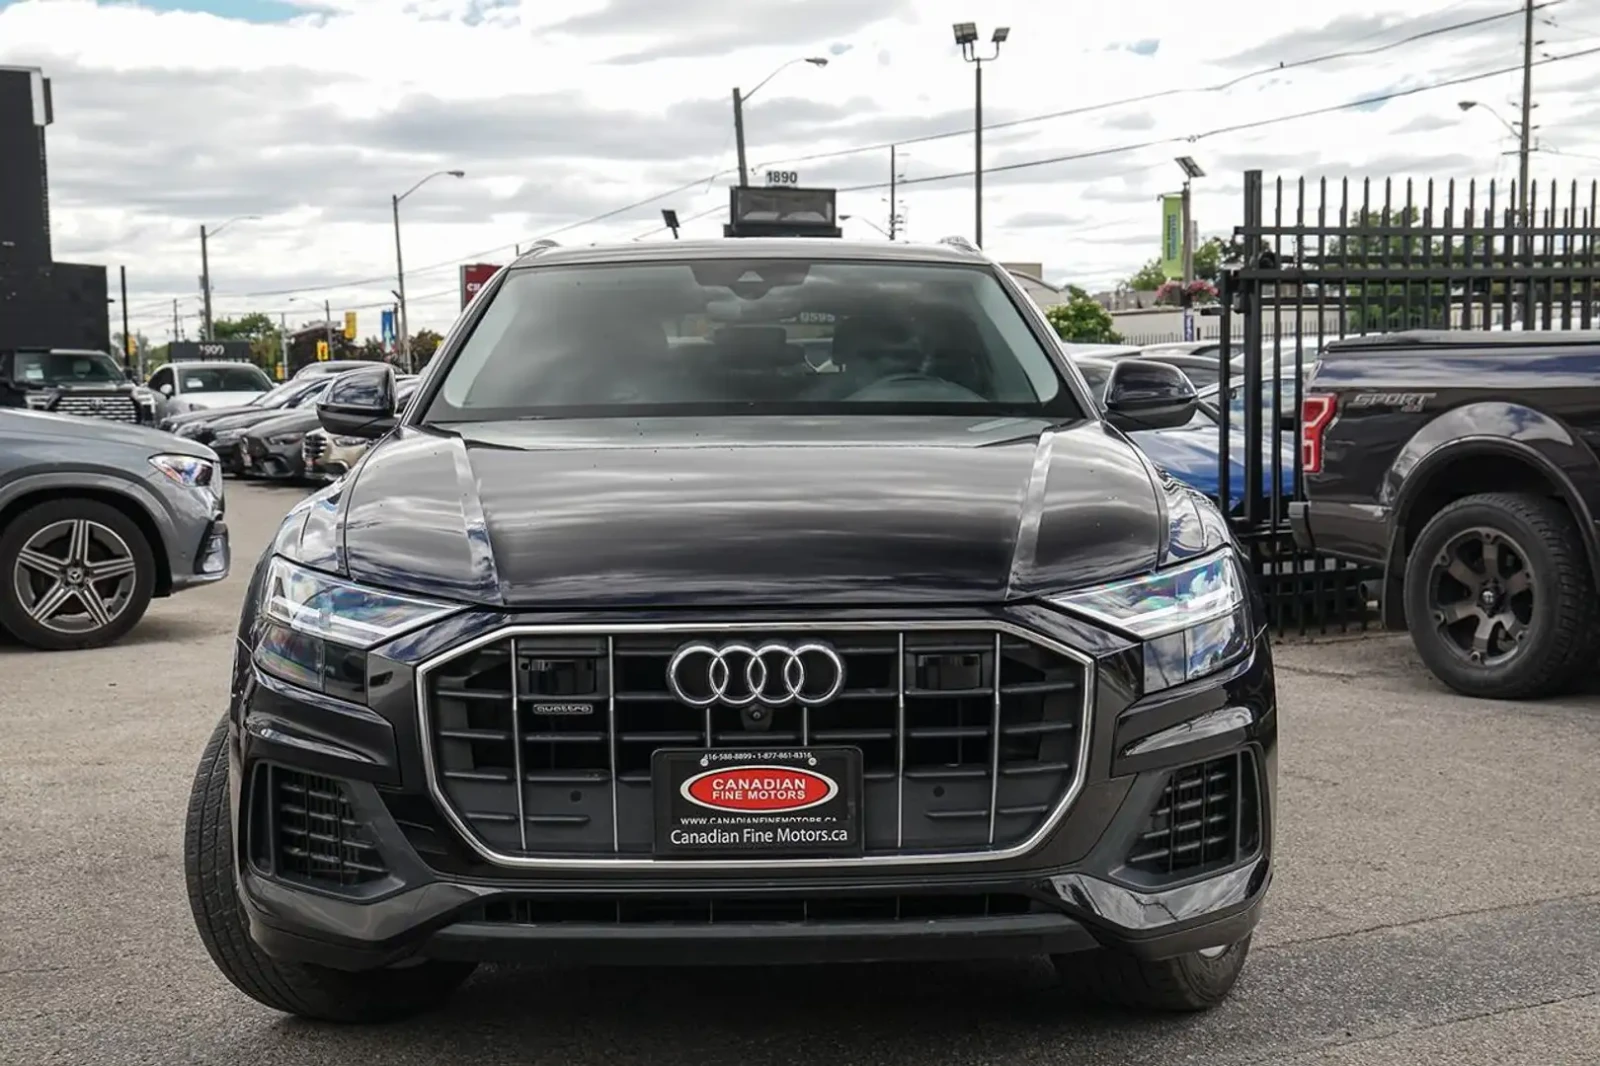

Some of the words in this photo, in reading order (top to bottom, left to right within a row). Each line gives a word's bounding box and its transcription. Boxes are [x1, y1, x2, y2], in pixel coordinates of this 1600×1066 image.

[766, 171, 798, 183] 1890
[1346, 392, 1437, 408] SPORT
[712, 778, 806, 790] CANADIAN
[712, 791, 743, 800] FINE
[748, 790, 806, 800] MOTORS
[670, 829, 740, 844] Canadian
[743, 828, 774, 843] Fine
[777, 828, 848, 842] Motors.ca
